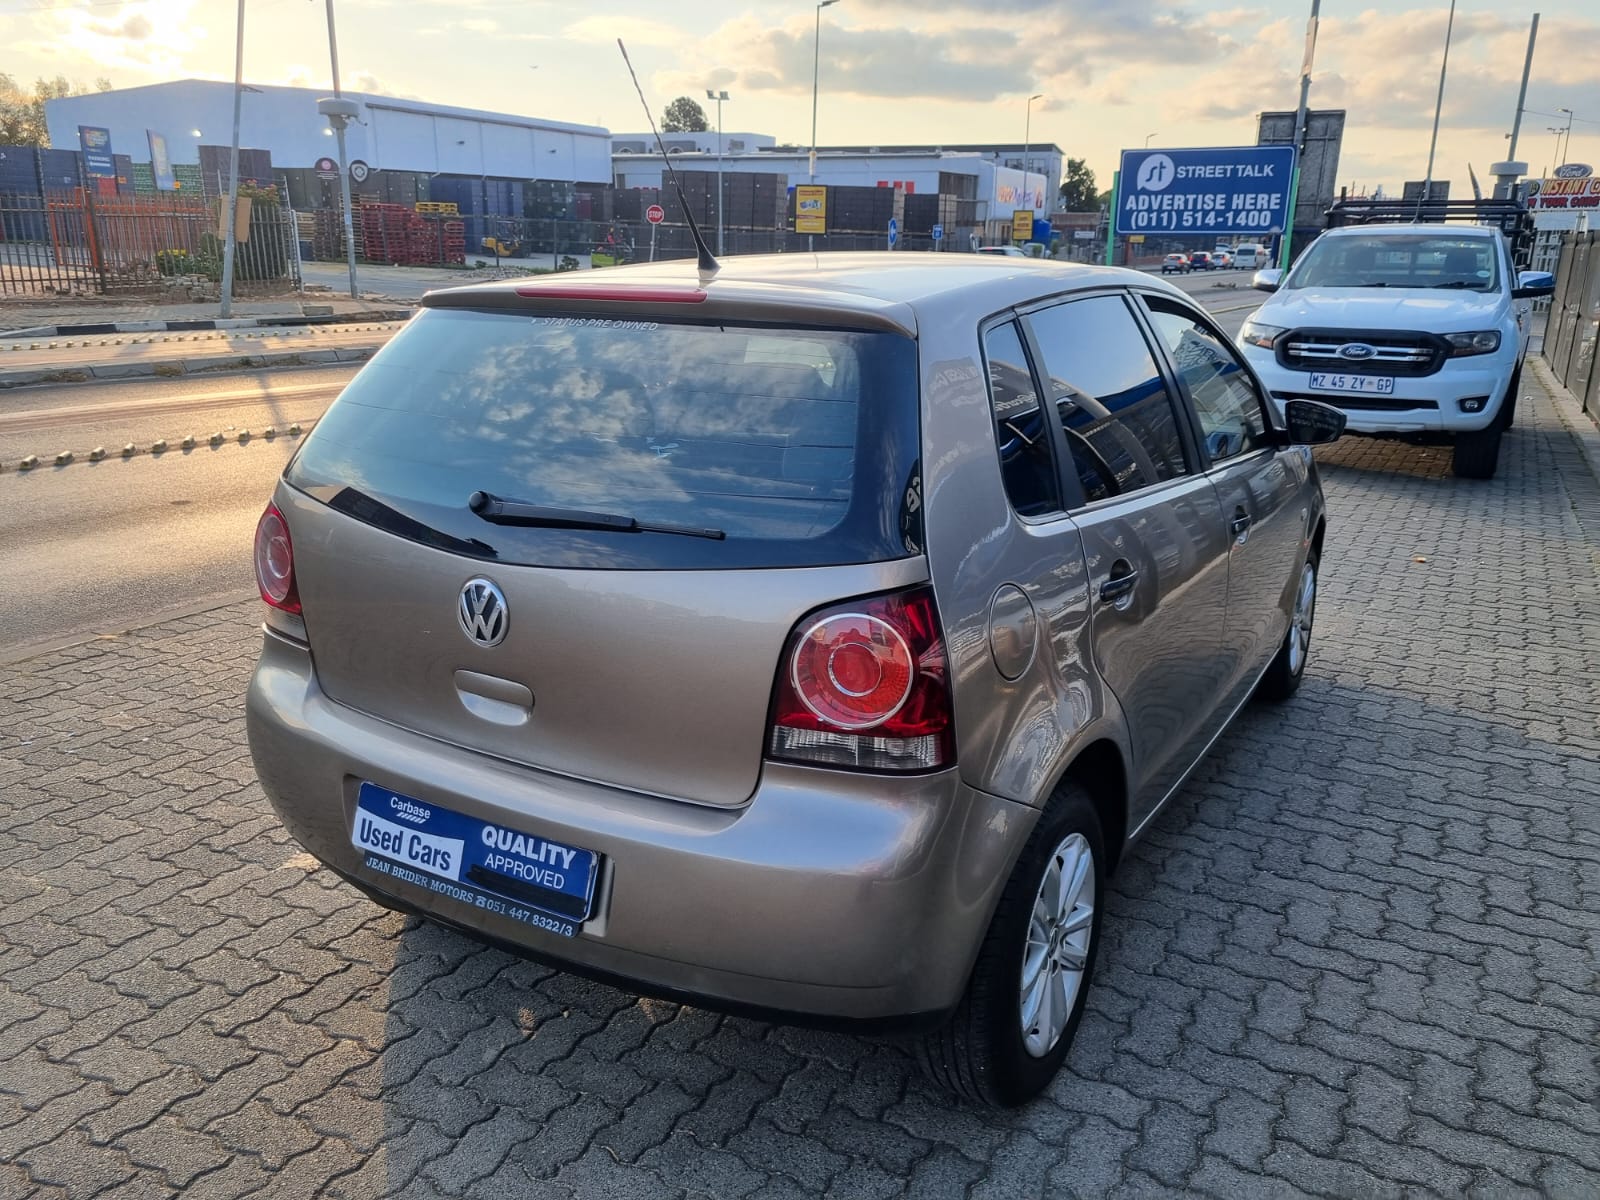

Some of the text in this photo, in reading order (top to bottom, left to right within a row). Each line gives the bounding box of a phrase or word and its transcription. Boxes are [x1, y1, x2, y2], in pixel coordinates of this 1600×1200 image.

[1176, 164, 1274, 179] STREET TALK
[1540, 179, 1590, 195] INSTANT
[1125, 193, 1281, 211] ADVERTISE HERE
[648, 210, 663, 219] STOP
[1130, 210, 1272, 230] (011) 514-1400
[542, 317, 659, 331] STATUS PRE OWNED
[1311, 374, 1392, 391] MZ 45 ZY GP
[390, 796, 431, 820] Carbase
[359, 817, 452, 872] Used Cars
[481, 824, 577, 870] QUALITY
[484, 852, 565, 890] APPROVED
[365, 856, 573, 937] JEAN BRIDER MOTORS 051 447 8322/3
